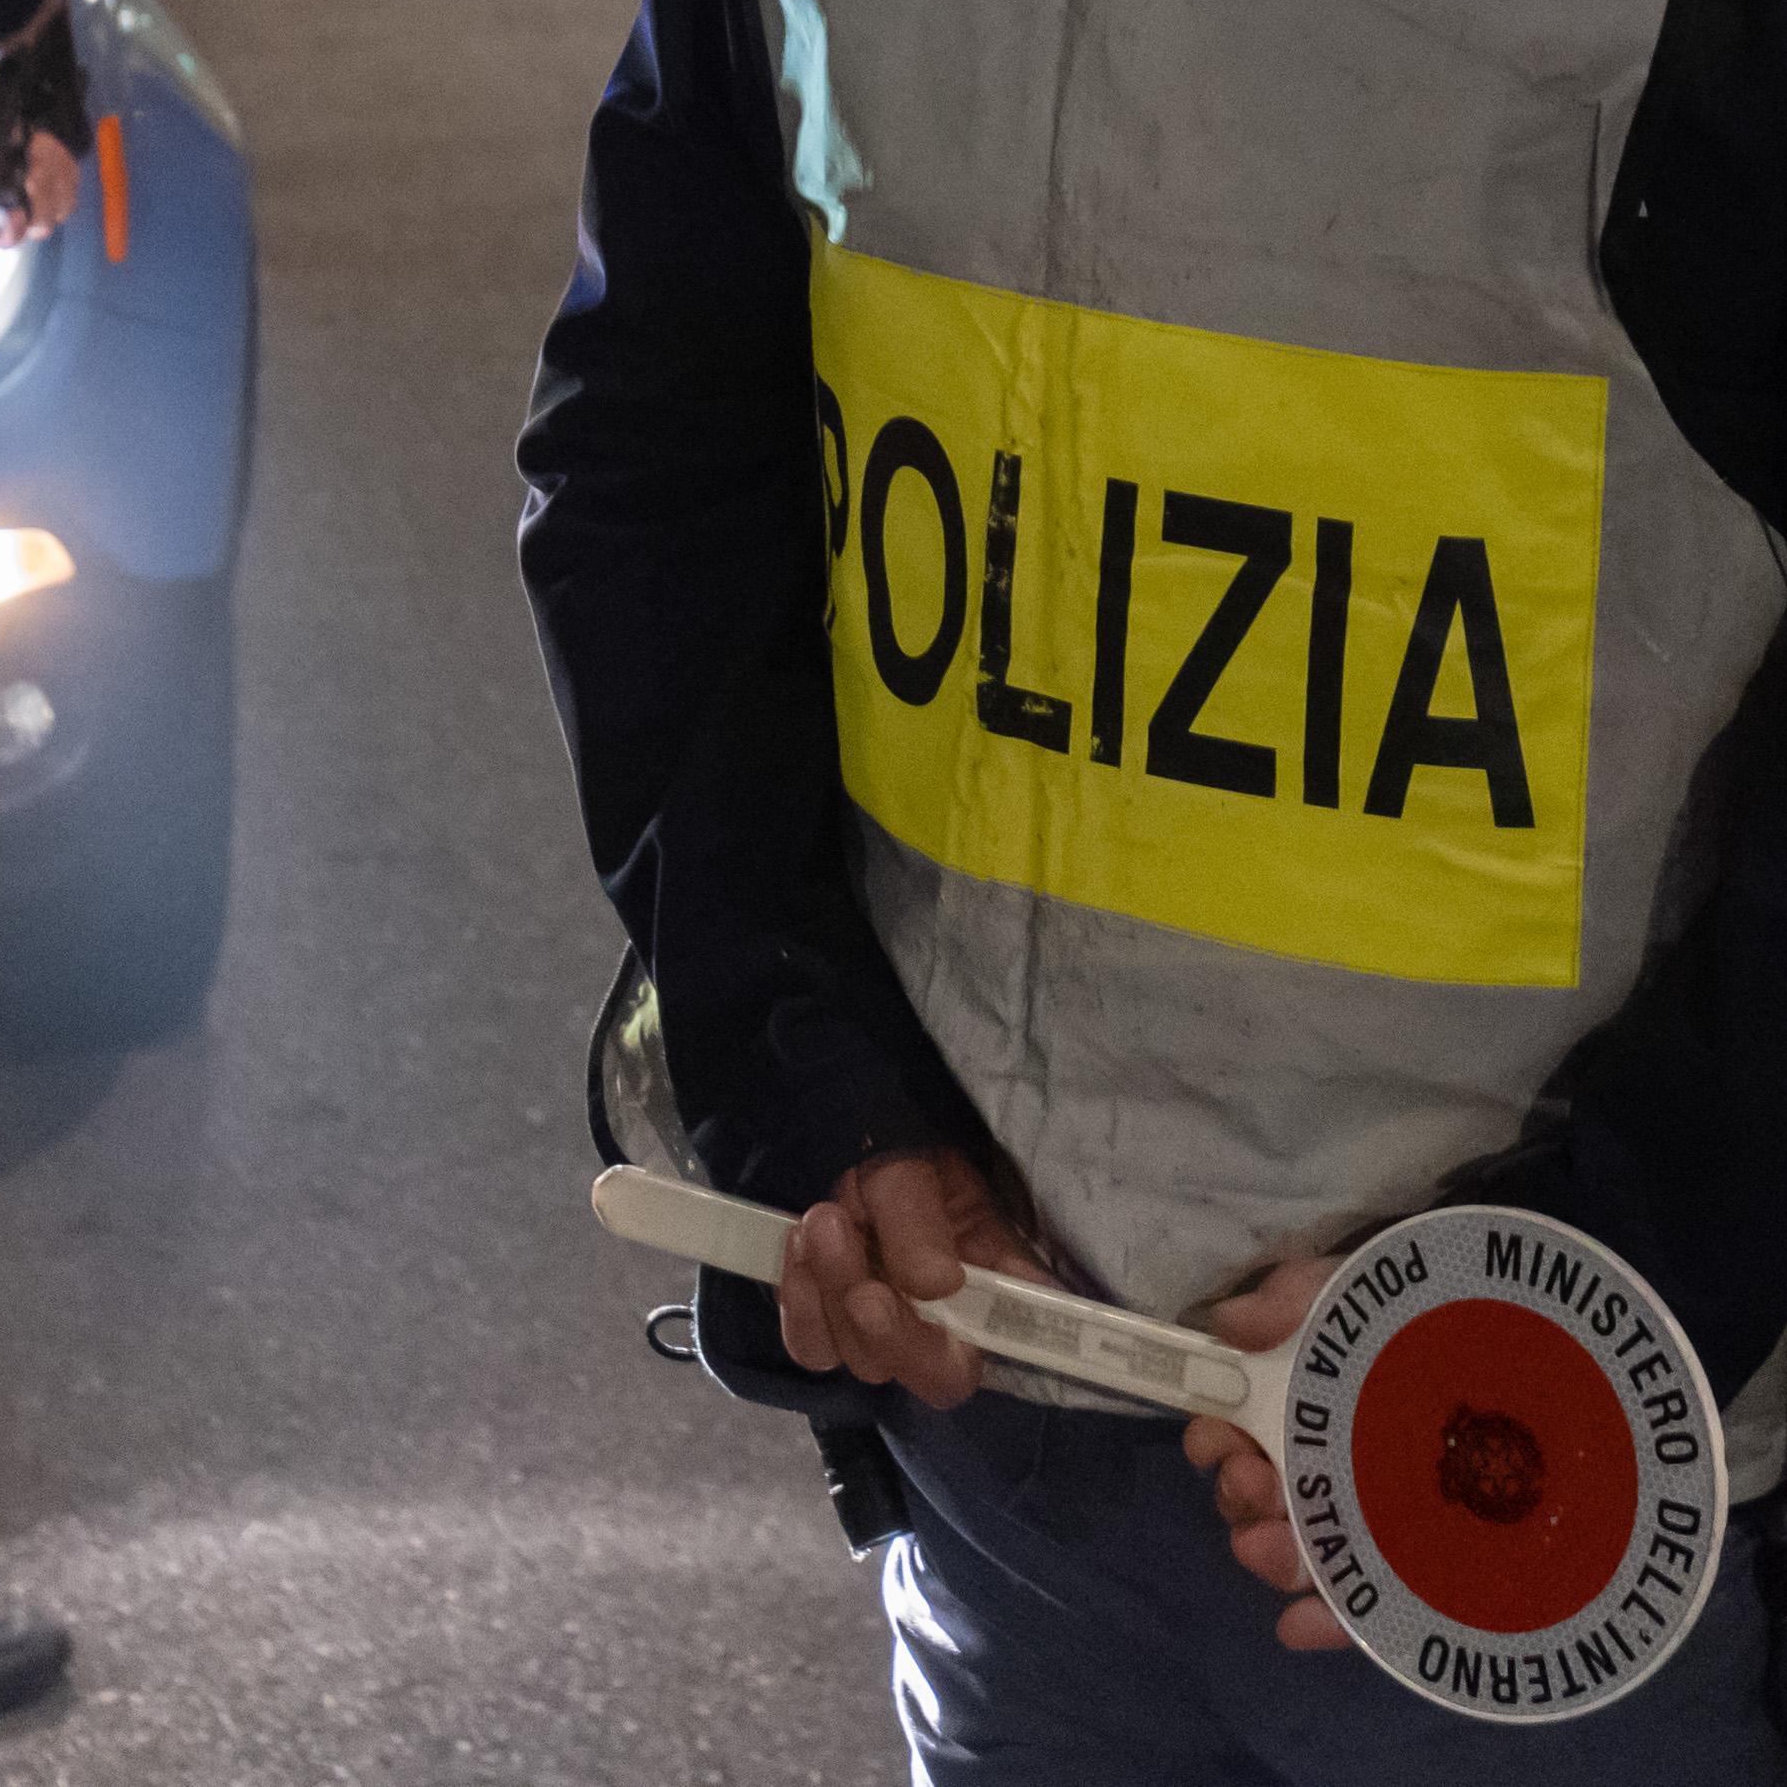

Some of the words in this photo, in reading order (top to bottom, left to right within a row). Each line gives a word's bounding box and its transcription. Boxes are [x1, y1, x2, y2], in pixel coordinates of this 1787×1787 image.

[814, 370, 1536, 829] POLIZIA
[1304, 1239, 1431, 1381] POLIZIA
[1484, 1229, 1700, 1468] MINISTERO
[1292, 1403, 1330, 1449] DI
[1296, 1472, 1380, 1621] STATO
[1417, 1500, 1702, 1705] DELL'INTERNO
